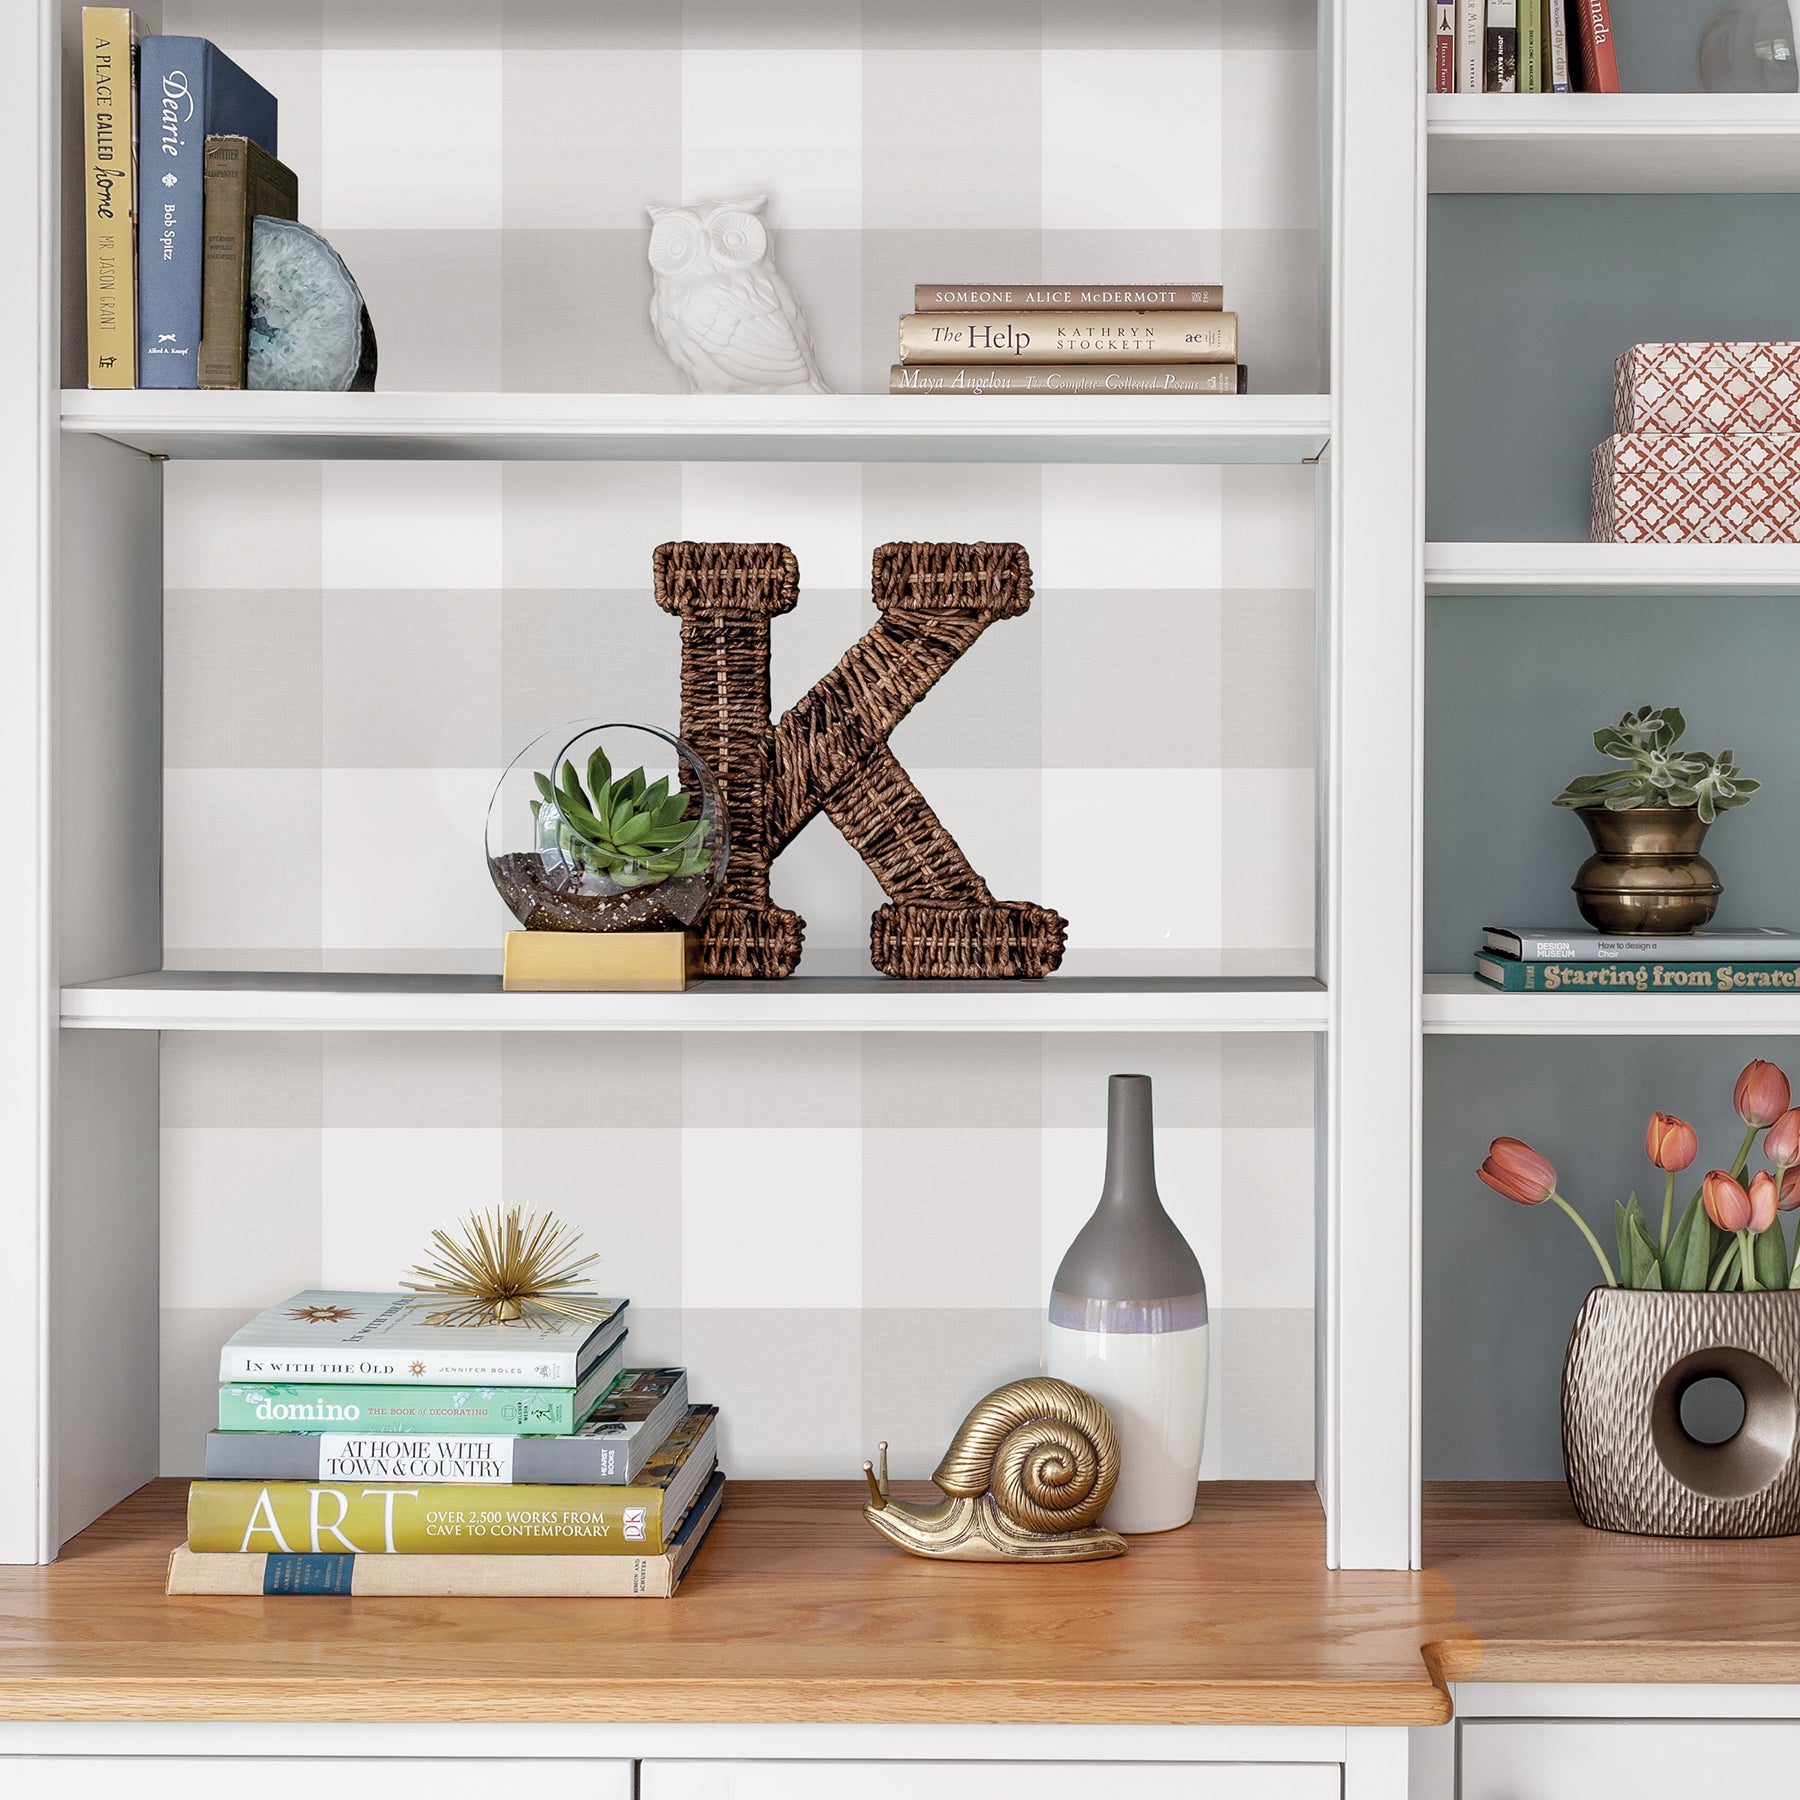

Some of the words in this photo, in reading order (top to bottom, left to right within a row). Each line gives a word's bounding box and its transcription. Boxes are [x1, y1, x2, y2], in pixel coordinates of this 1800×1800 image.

[1468, 13, 1477, 45] MAYLE
[1590, 0, 1609, 45] nada
[95, 37, 111, 49] A
[1554, 30, 1565, 52] day
[1555, 57, 1567, 77] day
[95, 55, 112, 107] PLACE
[161, 70, 194, 157] Dearie
[96, 113, 113, 161] CALLED
[93, 165, 125, 219] home
[163, 203, 177, 227] Bob
[98, 235, 115, 250] MR
[159, 230, 175, 261] Spitz
[98, 256, 115, 290] JASON
[935, 291, 1013, 303] SOMEONE
[1025, 291, 1072, 303] ALICE
[1081, 291, 1177, 303] McDERMOTT
[99, 296, 117, 332] GRANT
[931, 326, 963, 342] The
[967, 324, 1031, 356] Help
[1057, 327, 1155, 337] KATHRYN
[171, 347, 189, 356] Knopf
[1056, 340, 1156, 350] STOCKETT
[900, 369, 944, 395] Maya
[950, 368, 1012, 395] Angelou
[1046, 373, 1099, 393] Complete
[1105, 373, 1159, 390] Collected
[1163, 374, 1201, 390] Poems
[652, 541, 1068, 980] K
[1536, 942, 1570, 950] DESIGN
[1536, 950, 1576, 958] MUSEUM
[1598, 942, 1615, 950] How
[1616, 942, 1625, 950] to
[1626, 942, 1650, 952] design
[1598, 950, 1619, 958] Chair
[1543, 964, 1649, 991] Starting
[1652, 965, 1714, 986] from
[245, 1360, 264, 1372] IN
[270, 1363, 315, 1373] WITH
[320, 1363, 355, 1374] THE
[359, 1361, 394, 1374] OLD
[256, 1398, 361, 1421] domino
[390, 1408, 415, 1416] BOOK
[418, 1409, 426, 1417] of
[429, 1409, 489, 1417] DECORATING
[340, 1441, 367, 1458] AT
[371, 1441, 431, 1459] HOME
[436, 1442, 493, 1460] WITH
[600, 1448, 608, 1476] HEARST
[607, 1449, 615, 1475] BOOKS
[327, 1458, 389, 1476] TOWN
[392, 1459, 406, 1477] &
[409, 1459, 505, 1478] COUNTRY
[239, 1487, 419, 1553] ART
[426, 1511, 465, 1524] OVER
[506, 1511, 558, 1524] WORKS
[563, 1512, 605, 1524] FROM
[625, 1511, 641, 1538] DK
[426, 1524, 463, 1537] CAVE
[468, 1525, 486, 1537] TO
[490, 1525, 612, 1538] CONTEMPORARY
